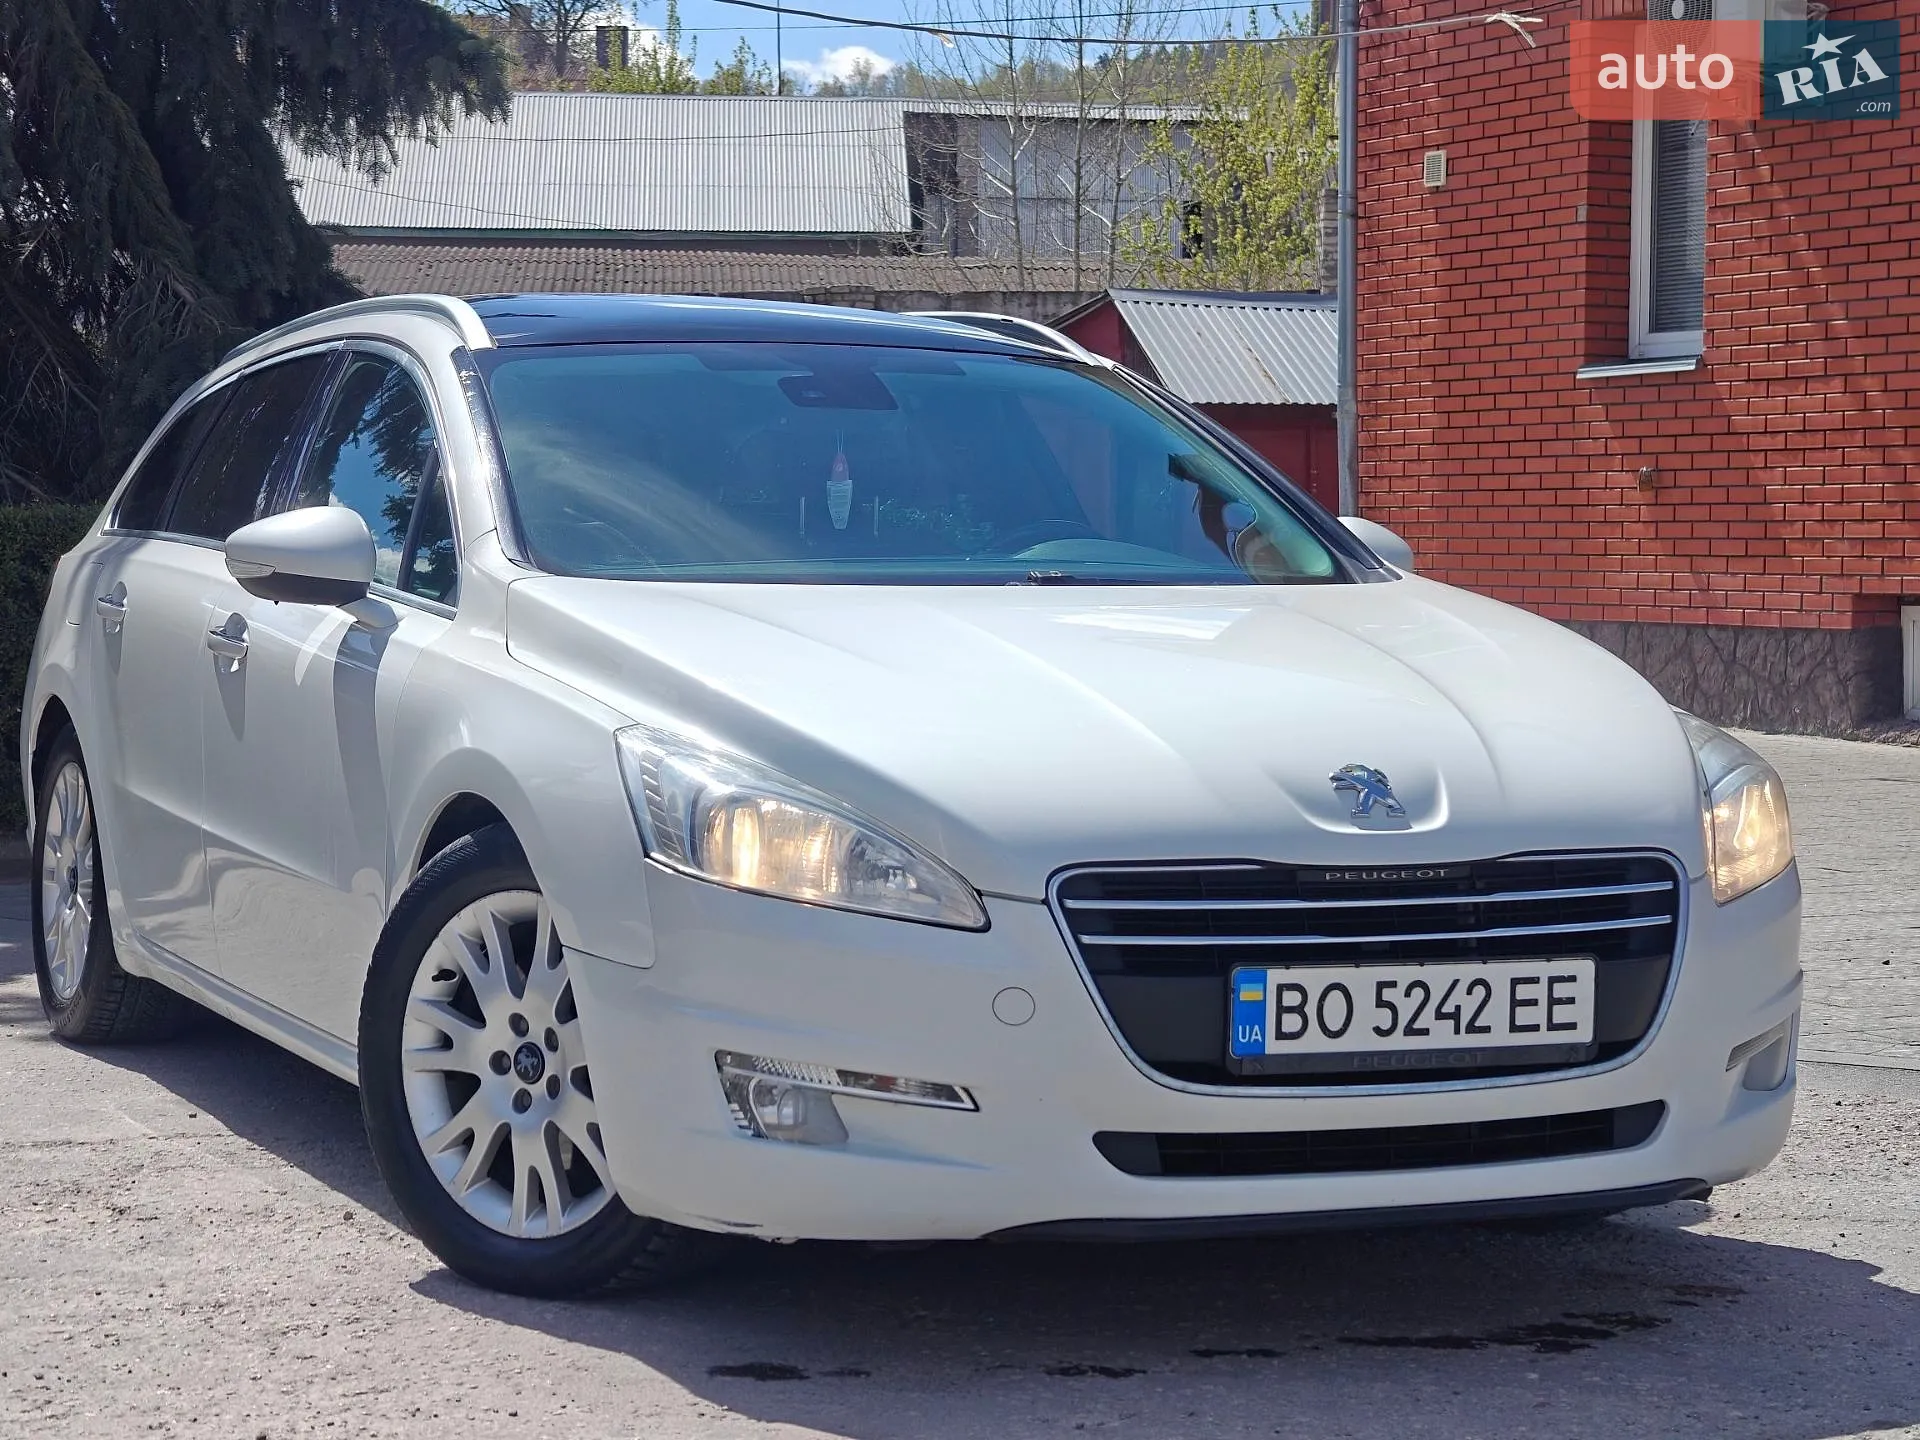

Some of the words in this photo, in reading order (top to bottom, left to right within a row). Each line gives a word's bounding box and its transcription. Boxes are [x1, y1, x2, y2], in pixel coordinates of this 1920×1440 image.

[1325, 868, 1449, 881] PEUGEOT
[1274, 982, 1354, 1041] BO
[1372, 978, 1493, 1038] 5242
[1508, 974, 1578, 1034] EE
[1238, 1025, 1263, 1043] UA
[1353, 1051, 1485, 1068] PEUGEOT
